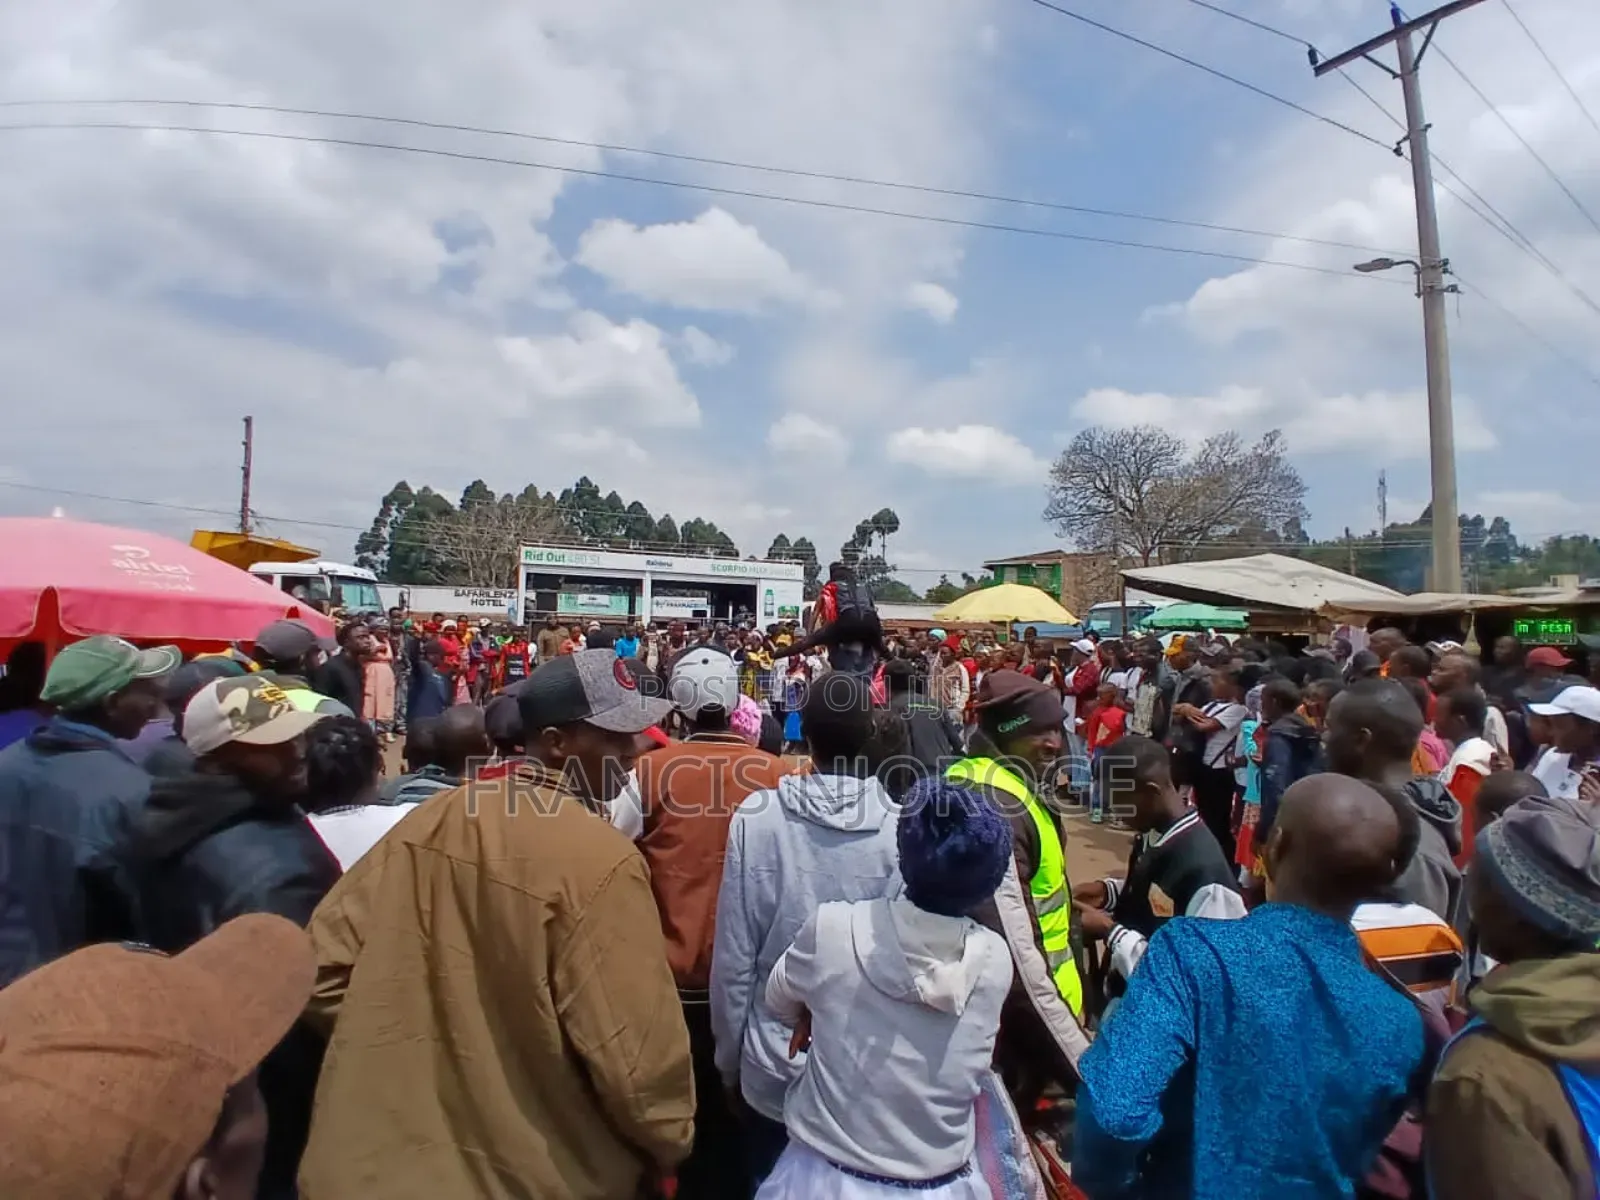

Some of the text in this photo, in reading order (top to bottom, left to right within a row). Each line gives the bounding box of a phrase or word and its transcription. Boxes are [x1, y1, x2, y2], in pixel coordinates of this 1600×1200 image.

[524, 550, 544, 561] Rid
[546, 552, 566, 563] Out
[711, 563, 748, 574] SCORPIO
[471, 598, 506, 607] HOTEL
